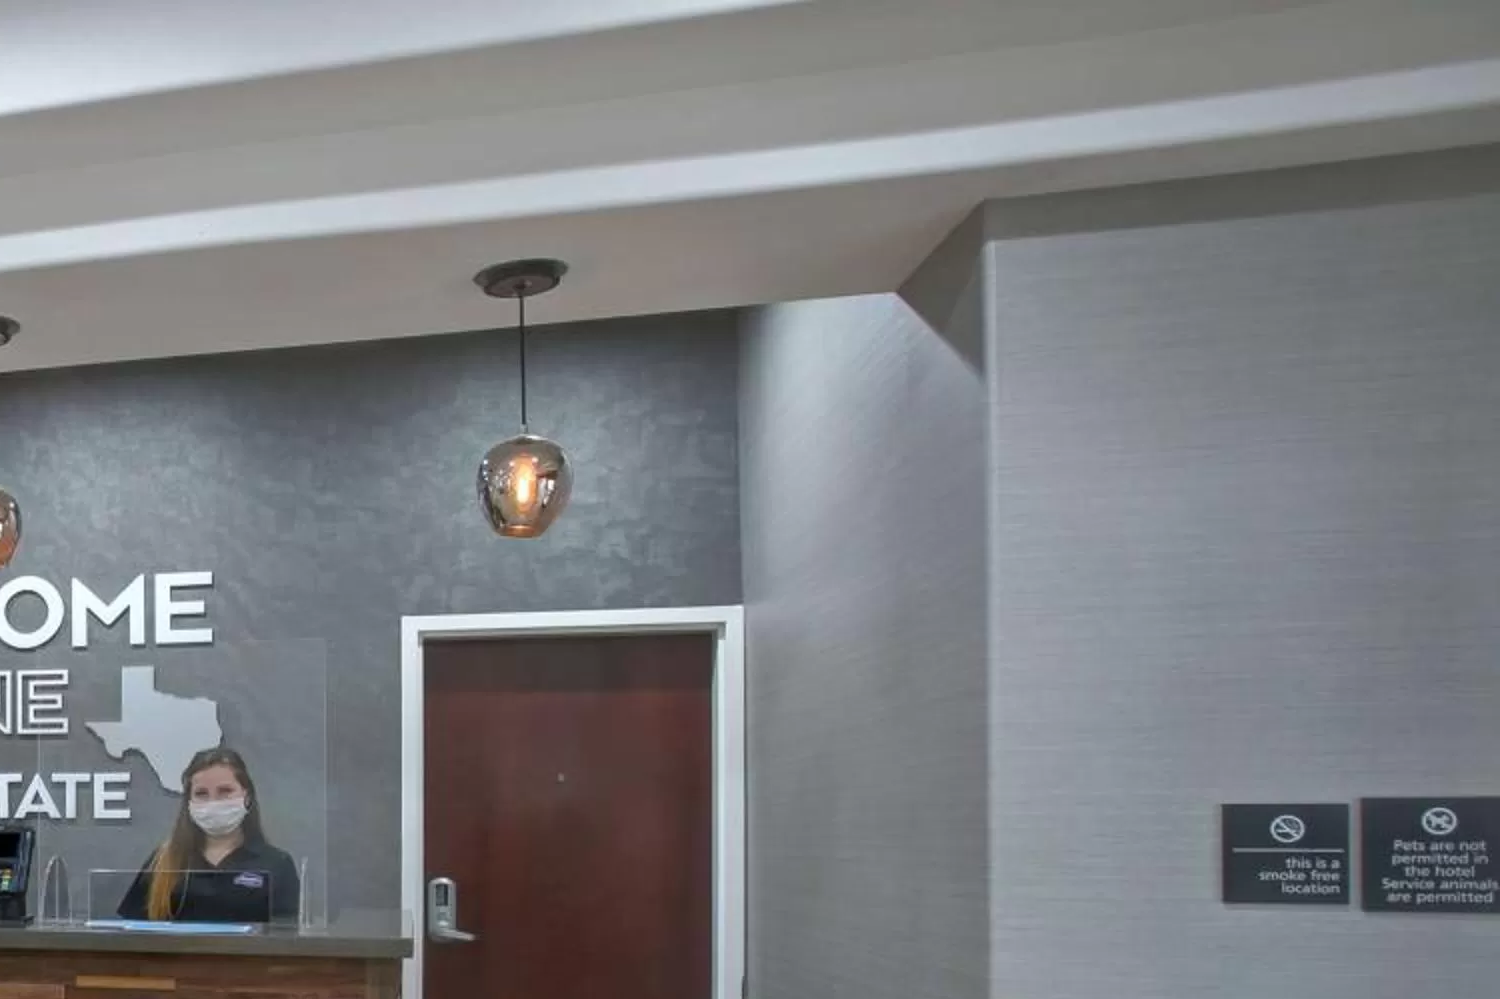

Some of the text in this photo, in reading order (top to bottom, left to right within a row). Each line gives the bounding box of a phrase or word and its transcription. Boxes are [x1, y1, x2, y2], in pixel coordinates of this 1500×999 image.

[1393, 840, 1487, 852] Pets are not
[1285, 857, 1341, 870] this is a
[1392, 853, 1489, 866] permitted in
[1258, 870, 1341, 882] smoke free
[1405, 866, 1476, 878] the hotel
[1281, 883, 1341, 895] location
[1382, 877, 1500, 891] Service animals
[1388, 891, 1494, 905] are permitted
